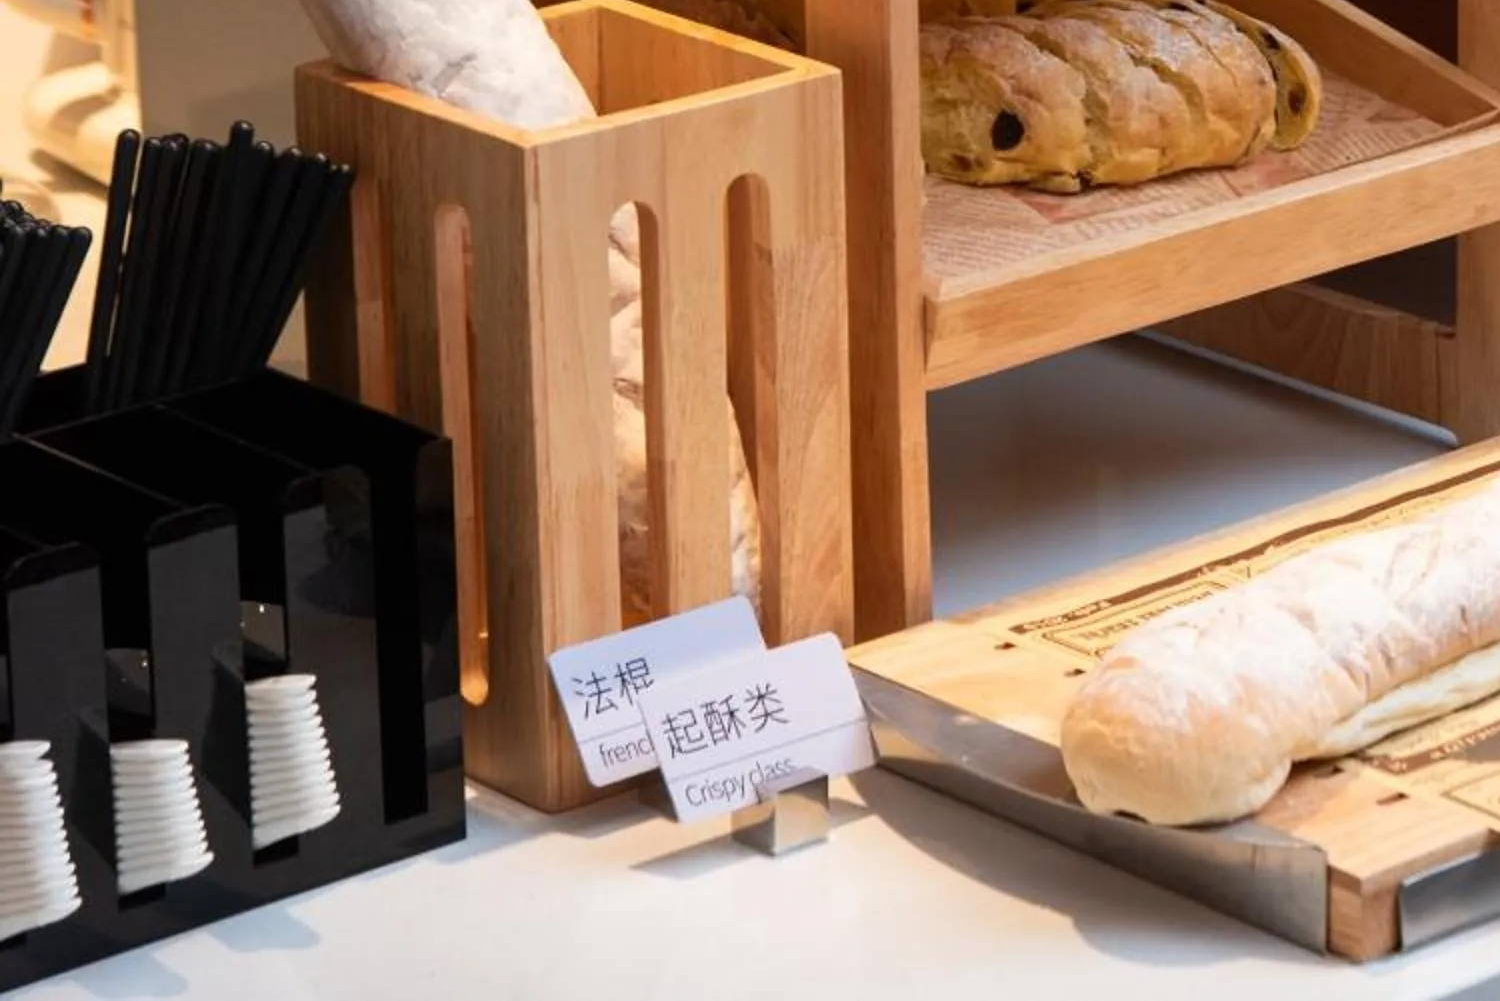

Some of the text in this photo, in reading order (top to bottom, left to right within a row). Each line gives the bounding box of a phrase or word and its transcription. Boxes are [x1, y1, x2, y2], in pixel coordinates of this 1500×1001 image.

[571, 657, 655, 719] 法棍
[661, 682, 790, 759] 起酥类
[684, 773, 746, 807] Crispy
